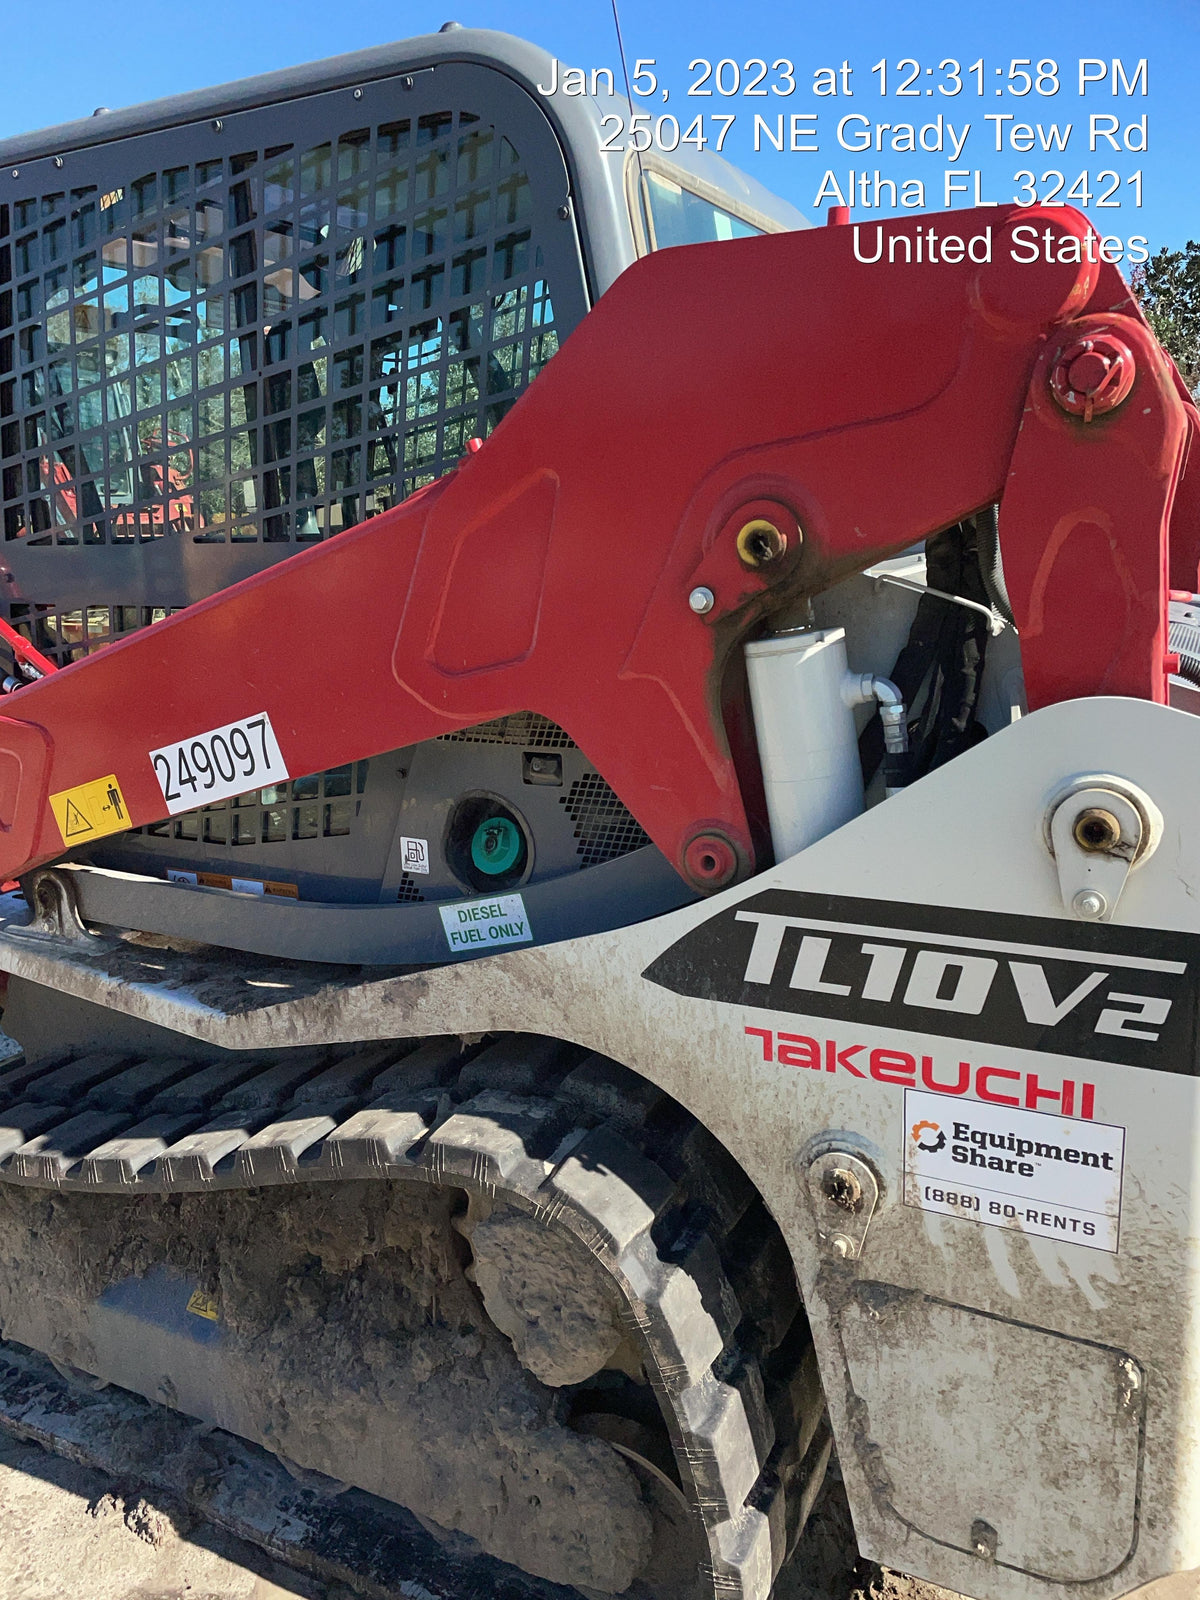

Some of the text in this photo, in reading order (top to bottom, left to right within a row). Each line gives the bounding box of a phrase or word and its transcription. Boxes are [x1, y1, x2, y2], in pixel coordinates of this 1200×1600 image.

[153, 718, 271, 801] 249097
[450, 921, 524, 945] FUEL ONLY
[457, 903, 508, 923] DIESEL
[735, 910, 1187, 1042] TL10V2
[952, 1121, 1114, 1171] Equipment
[924, 1186, 1096, 1236] (888) 80-RENTS
